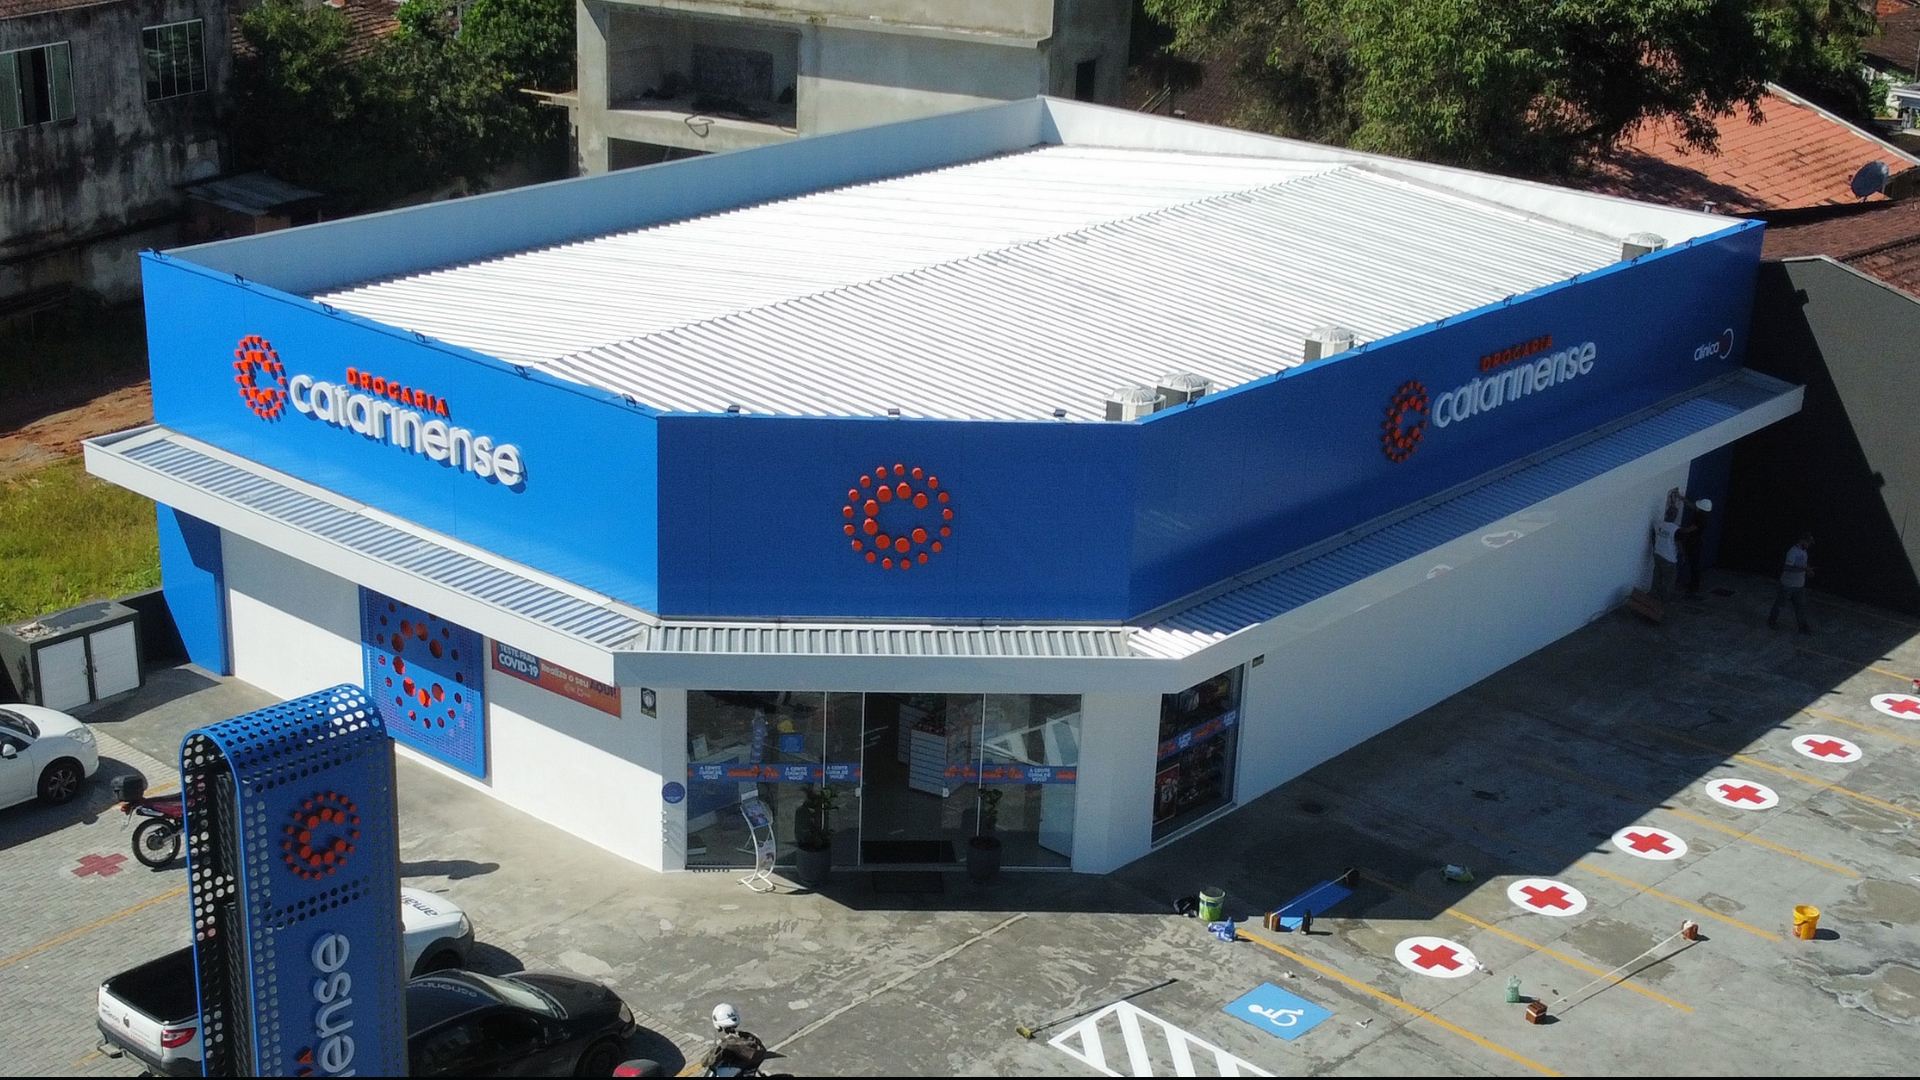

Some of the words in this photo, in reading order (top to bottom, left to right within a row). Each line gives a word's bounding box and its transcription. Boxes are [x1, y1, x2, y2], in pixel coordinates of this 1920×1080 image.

[1479, 334, 1553, 372] DROGARIA
[347, 367, 450, 416] DROGARIA
[1432, 341, 1597, 428] catarinense
[290, 374, 523, 486] catarinense
[499, 653, 539, 677] COVID-19
[500, 644, 519, 658] TESTE
[575, 677, 589, 688] seu
[312, 932, 356, 1077] ense
